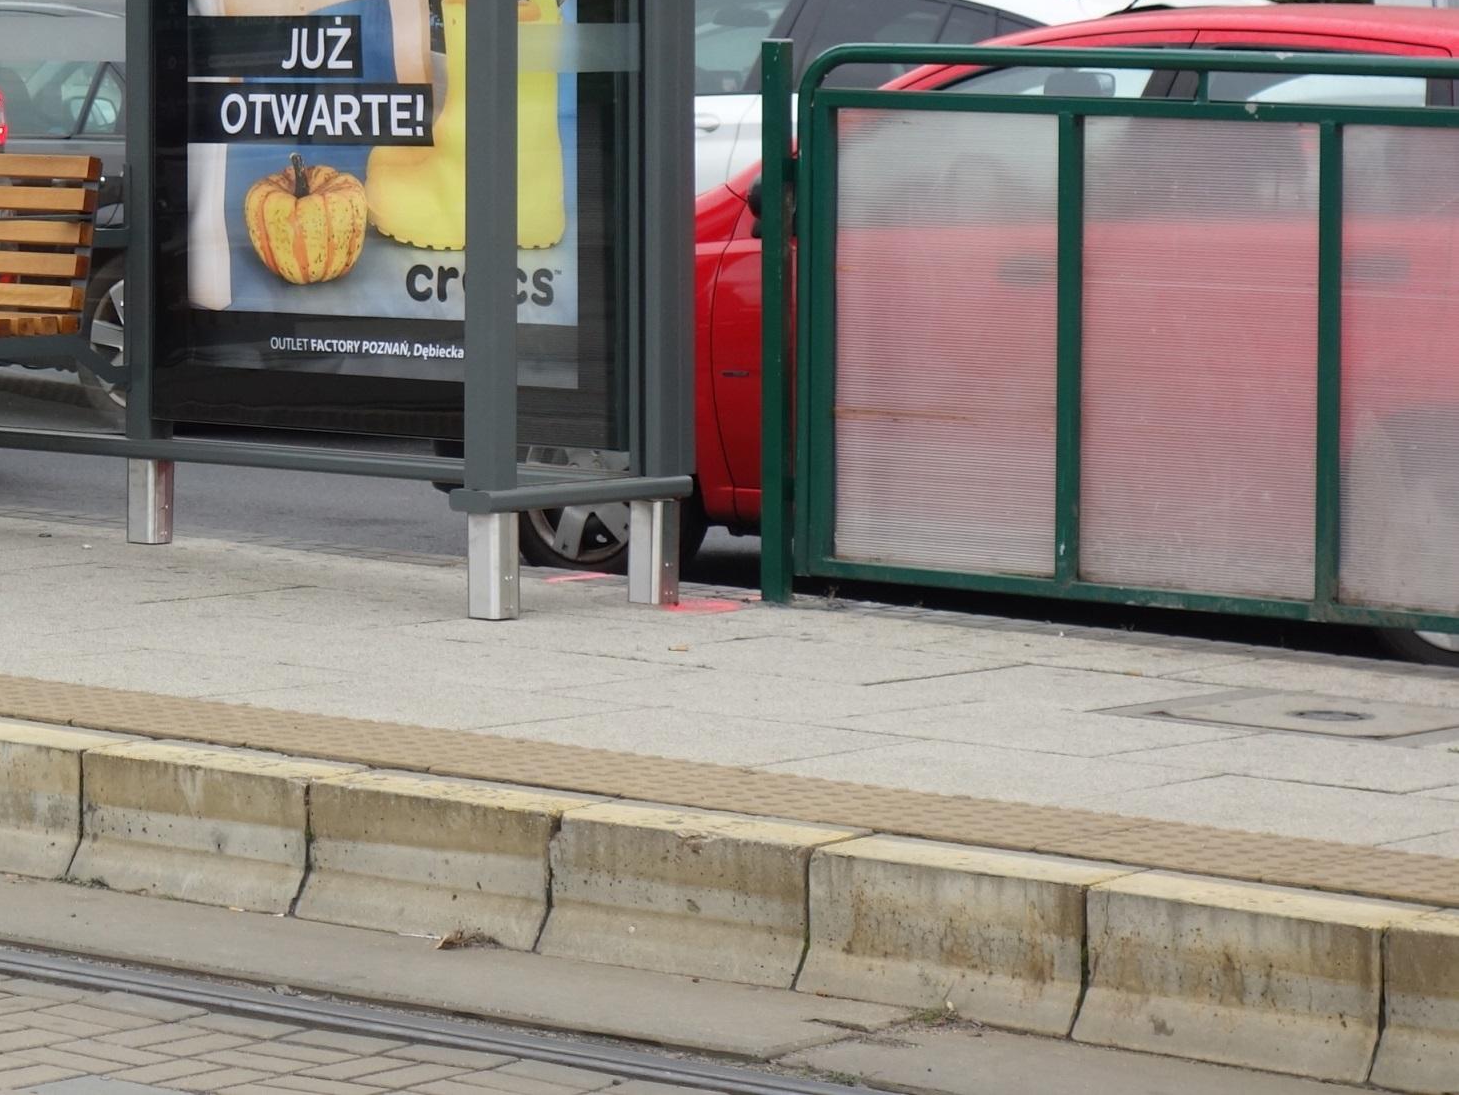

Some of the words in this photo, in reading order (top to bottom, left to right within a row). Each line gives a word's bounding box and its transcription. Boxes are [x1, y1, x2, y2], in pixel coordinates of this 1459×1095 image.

[282, 16, 353, 69] JUŻ
[220, 93, 424, 137] OTWARTE!
[270, 336, 309, 350] OUTLET
[311, 339, 360, 354] FACTORY
[362, 339, 411, 356] POZNAŃ,
[413, 344, 465, 360] Dębiecka
